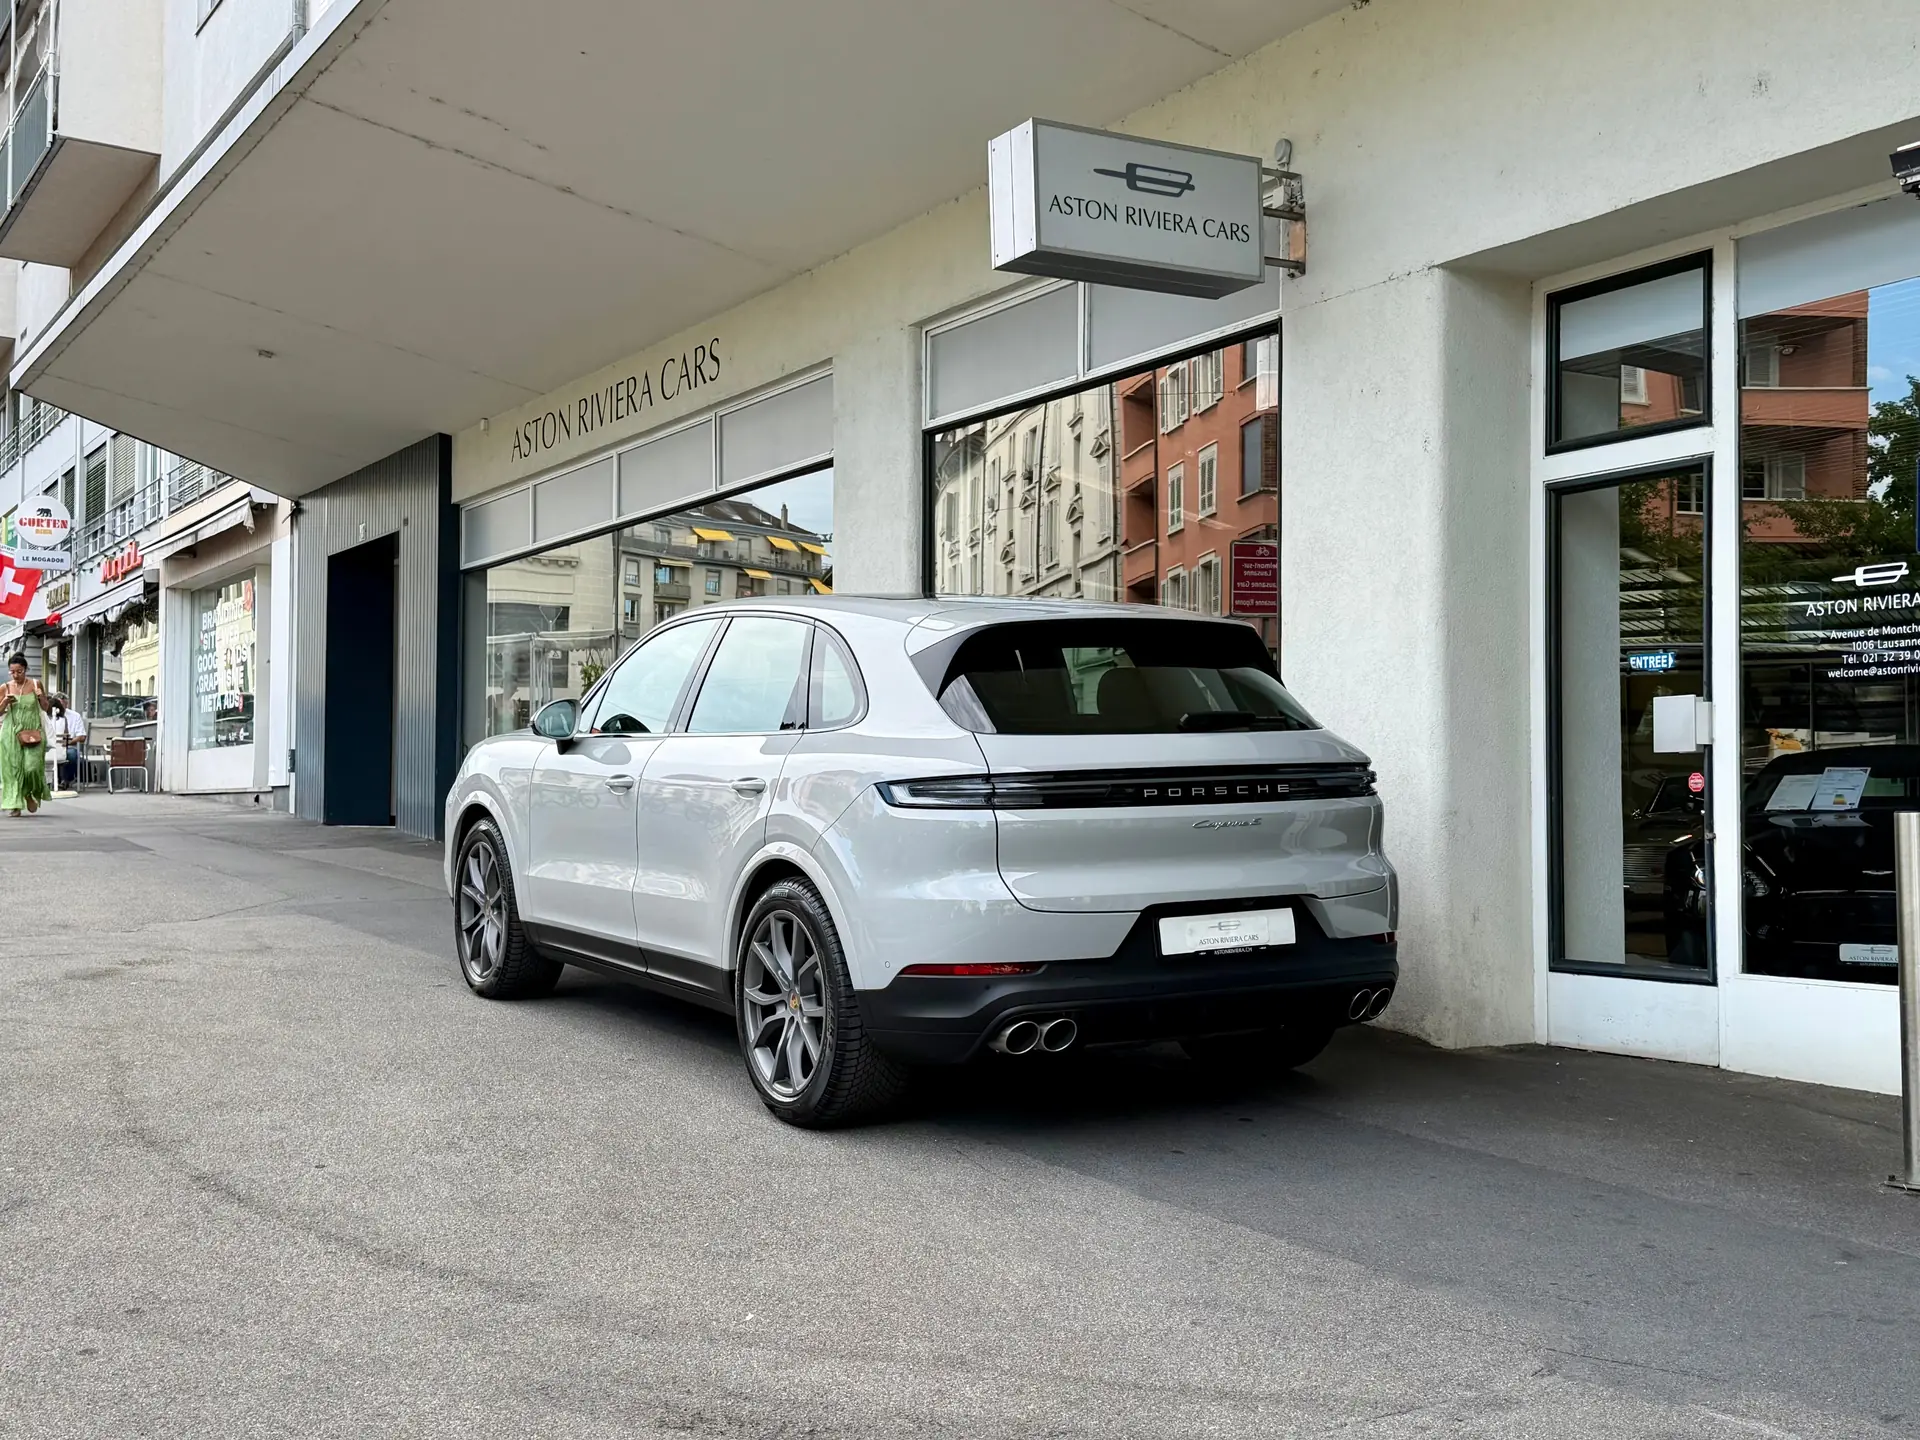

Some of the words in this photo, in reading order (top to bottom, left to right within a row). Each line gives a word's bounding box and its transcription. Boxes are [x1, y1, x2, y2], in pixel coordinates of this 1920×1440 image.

[1048, 194, 1118, 222] ASTON
[1126, 205, 1198, 236] RIVIERA
[1203, 217, 1250, 243] CARS
[511, 404, 572, 462] ASTON
[577, 370, 654, 436] RIVIERA
[660, 336, 721, 401] CARS
[18, 517, 69, 529] GURTEN
[1806, 598, 1858, 617] ASTON
[1863, 592, 1920, 612] RIVIERA
[202, 602, 243, 631] BRANDING
[1830, 630, 1865, 640] Avenue
[1867, 626, 1879, 637] de
[1852, 640, 1874, 651] 1006
[197, 648, 227, 673] GOOGE
[1630, 655, 1668, 669] ENTREE
[1842, 654, 1860, 664] Tél.
[1862, 653, 1878, 663] 021
[1883, 651, 1895, 662] 32
[1898, 650, 1911, 661] 39
[201, 692, 222, 713] META
[223, 690, 240, 710] ADS
[1143, 784, 1290, 798] PORSCHE
[1191, 819, 1250, 831] Cayenne
[1198, 936, 1220, 946] ASTON
[1220, 935, 1243, 944] RIVIERA
[1243, 933, 1260, 942] CARS
